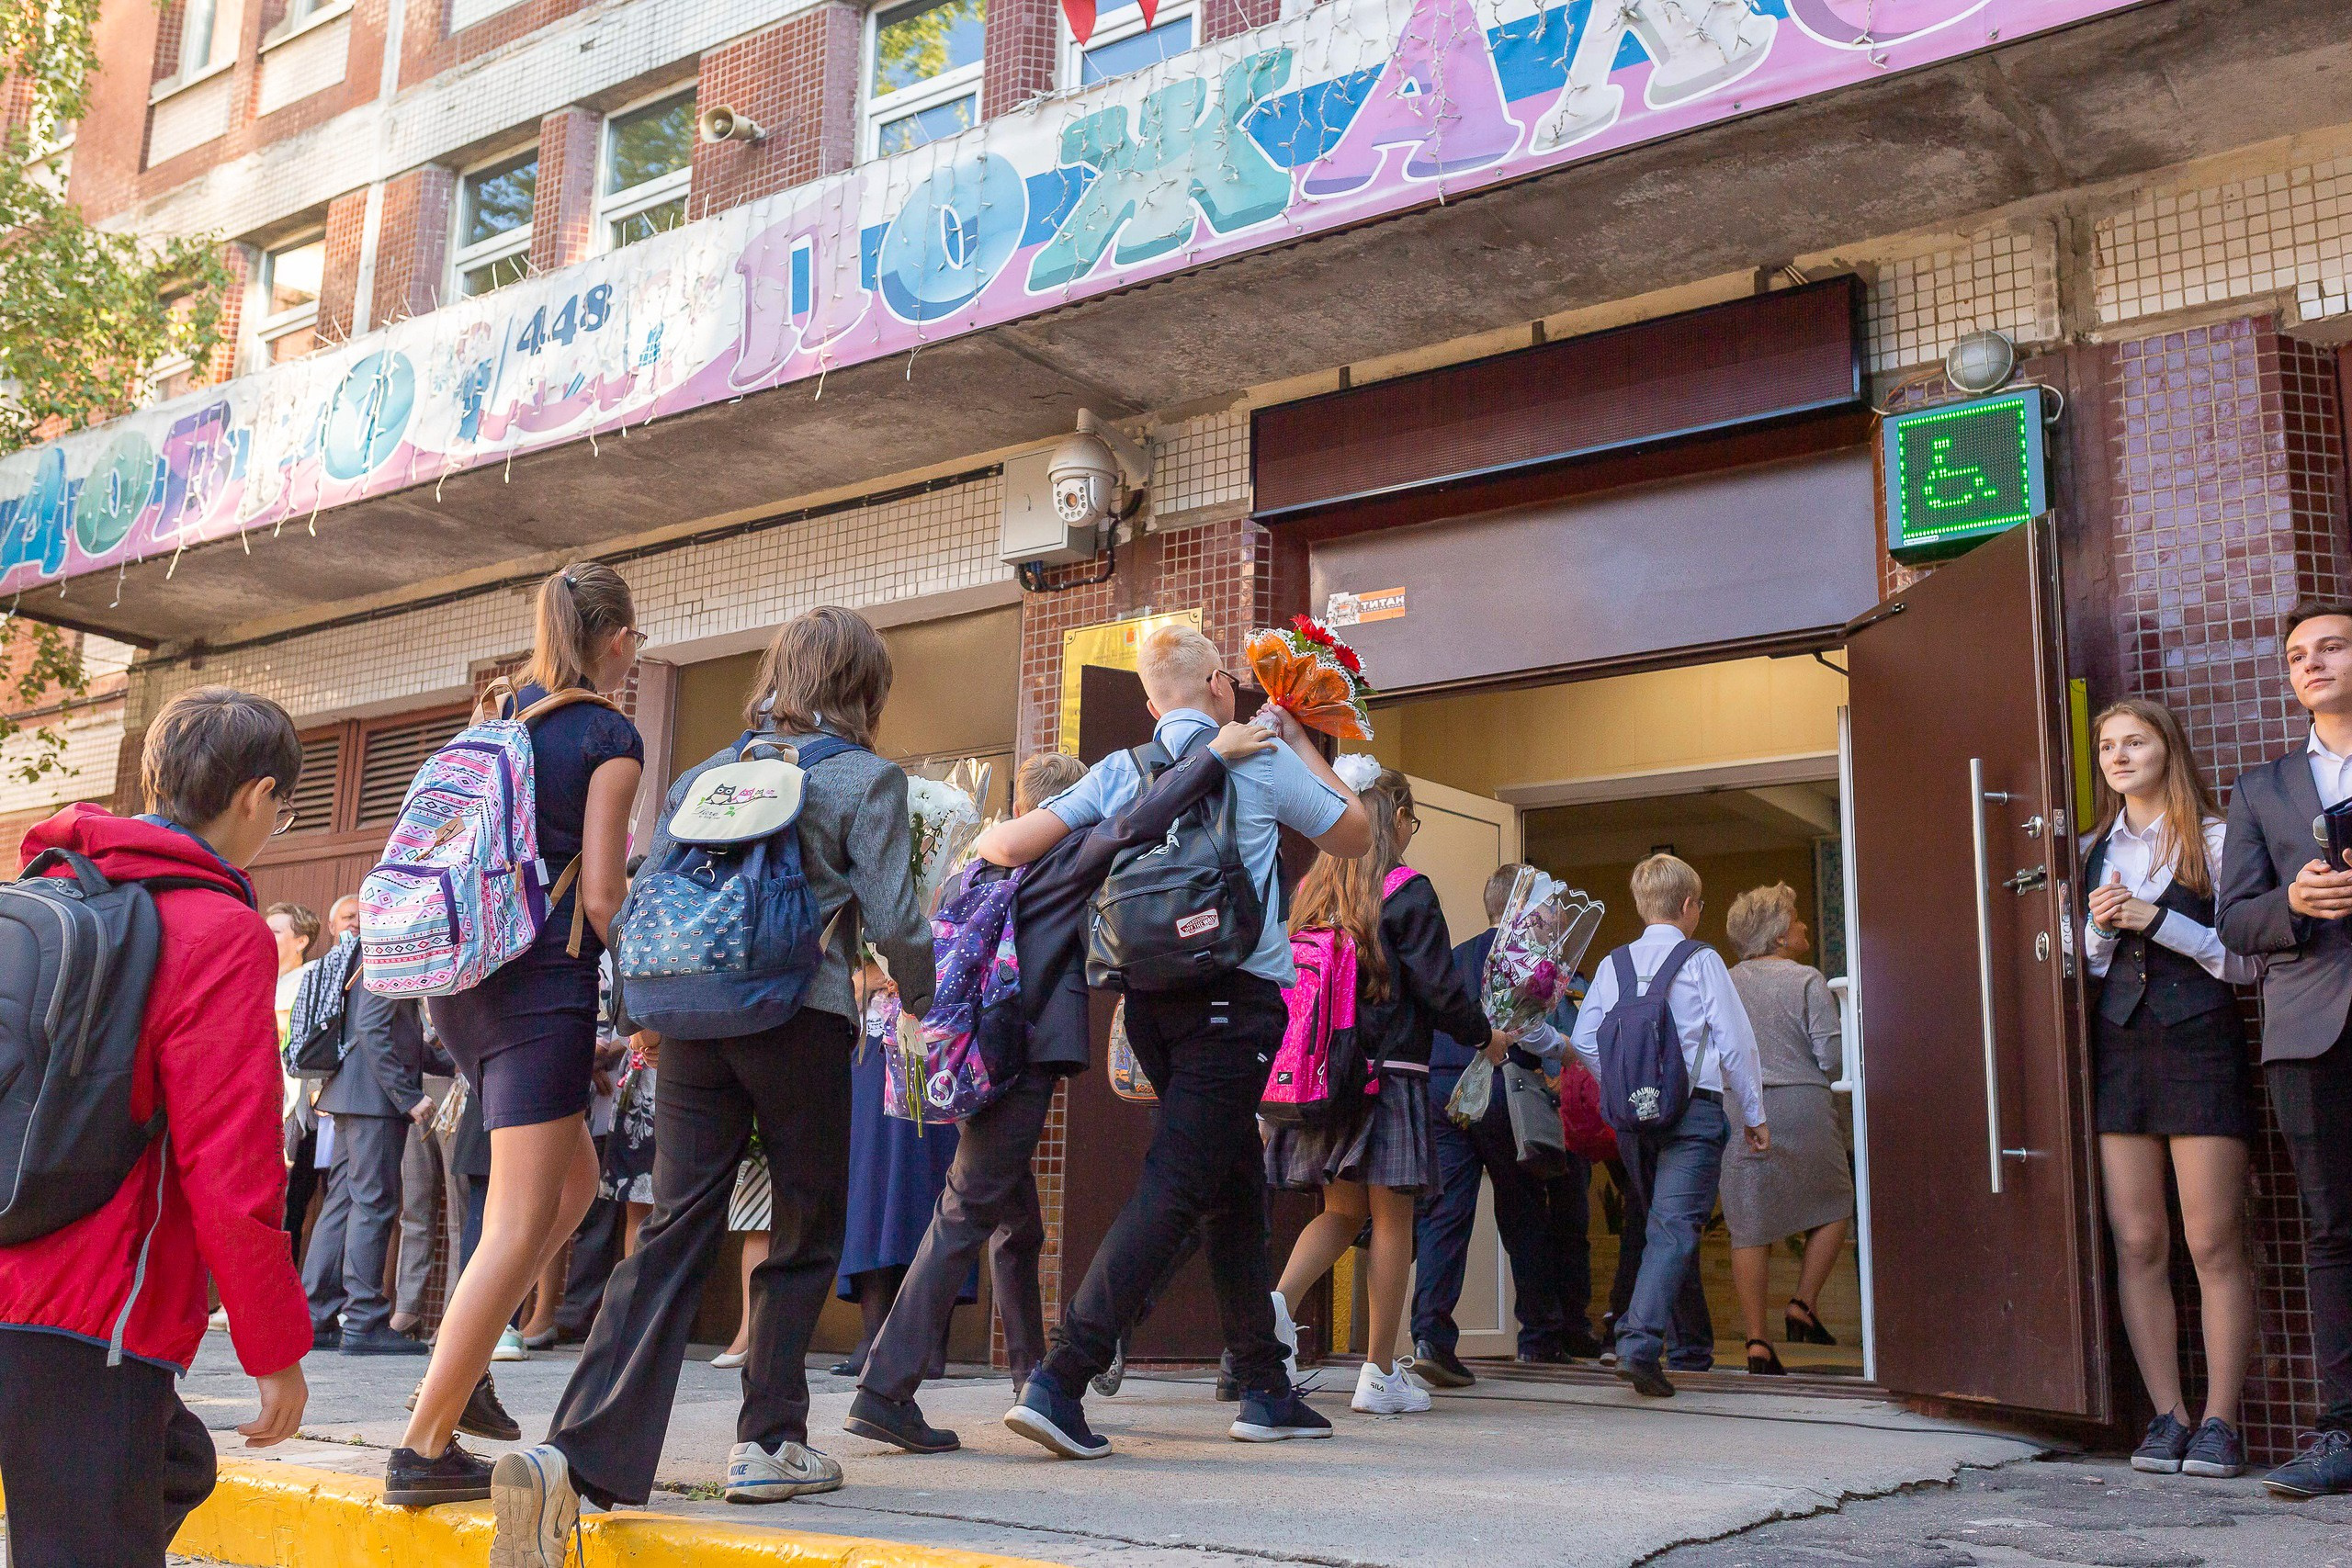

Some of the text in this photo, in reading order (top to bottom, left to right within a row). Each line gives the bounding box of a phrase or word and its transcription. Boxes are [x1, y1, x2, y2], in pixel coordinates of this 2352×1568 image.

[729, 0, 1996, 393] ПОЖАЛ
[515, 283, 613, 356] 448
[1360, 595, 1405, 610] ТИТАН
[1370, 1382, 1385, 1393] FILA
[729, 1463, 749, 1476] NIKE
